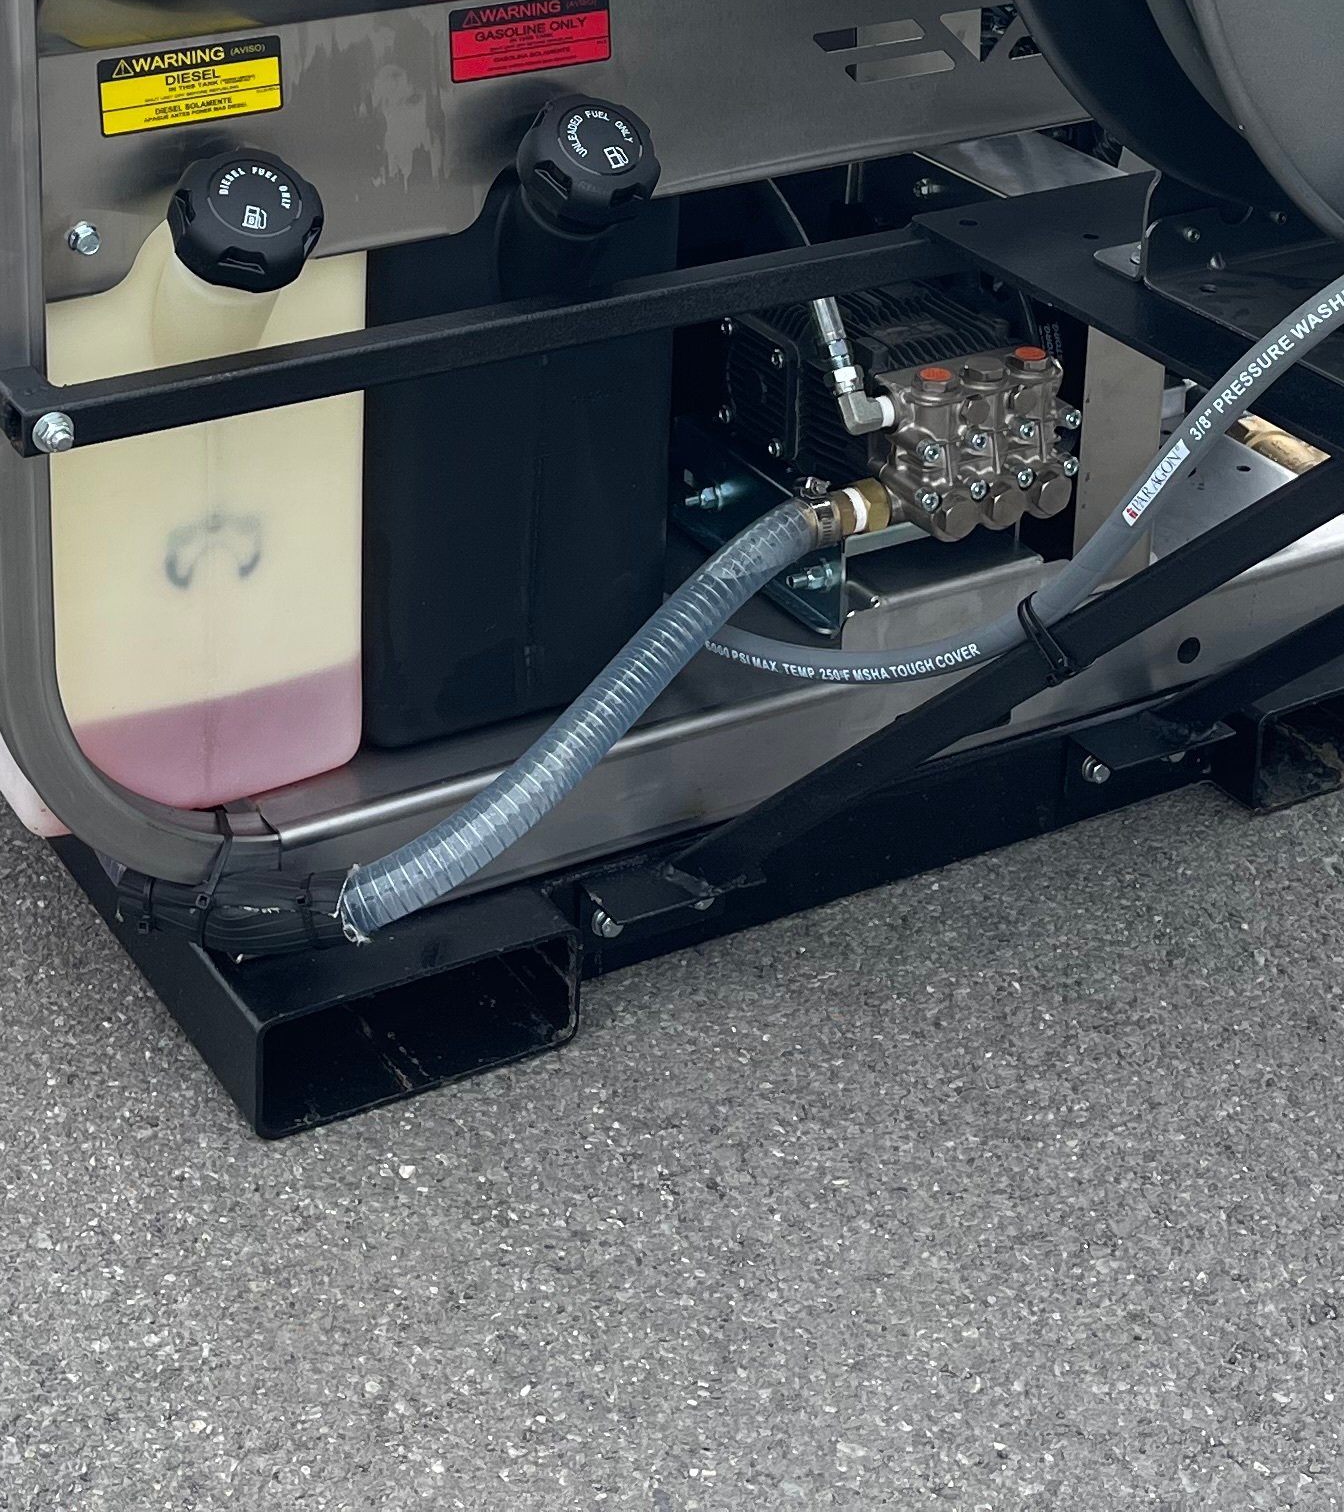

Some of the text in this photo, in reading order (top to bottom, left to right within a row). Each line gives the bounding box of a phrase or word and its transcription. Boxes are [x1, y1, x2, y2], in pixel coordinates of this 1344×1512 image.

[479, 0, 561, 23] WARNING
[474, 17, 587, 42] GASOLINE ONLY
[132, 43, 266, 73] WARNING (AVISO)
[165, 69, 221, 86] DIESEL
[584, 110, 610, 122] FUEL
[614, 120, 634, 143] ONLY
[218, 167, 246, 195] DIESEL
[251, 166, 277, 183] FUEL
[1212, 334, 1295, 414] PRESSURE
[730, 648, 751, 667] PSI
[852, 667, 890, 682] MSHA
[889, 659, 935, 679] TOUGH
[935, 642, 981, 669] COVER
